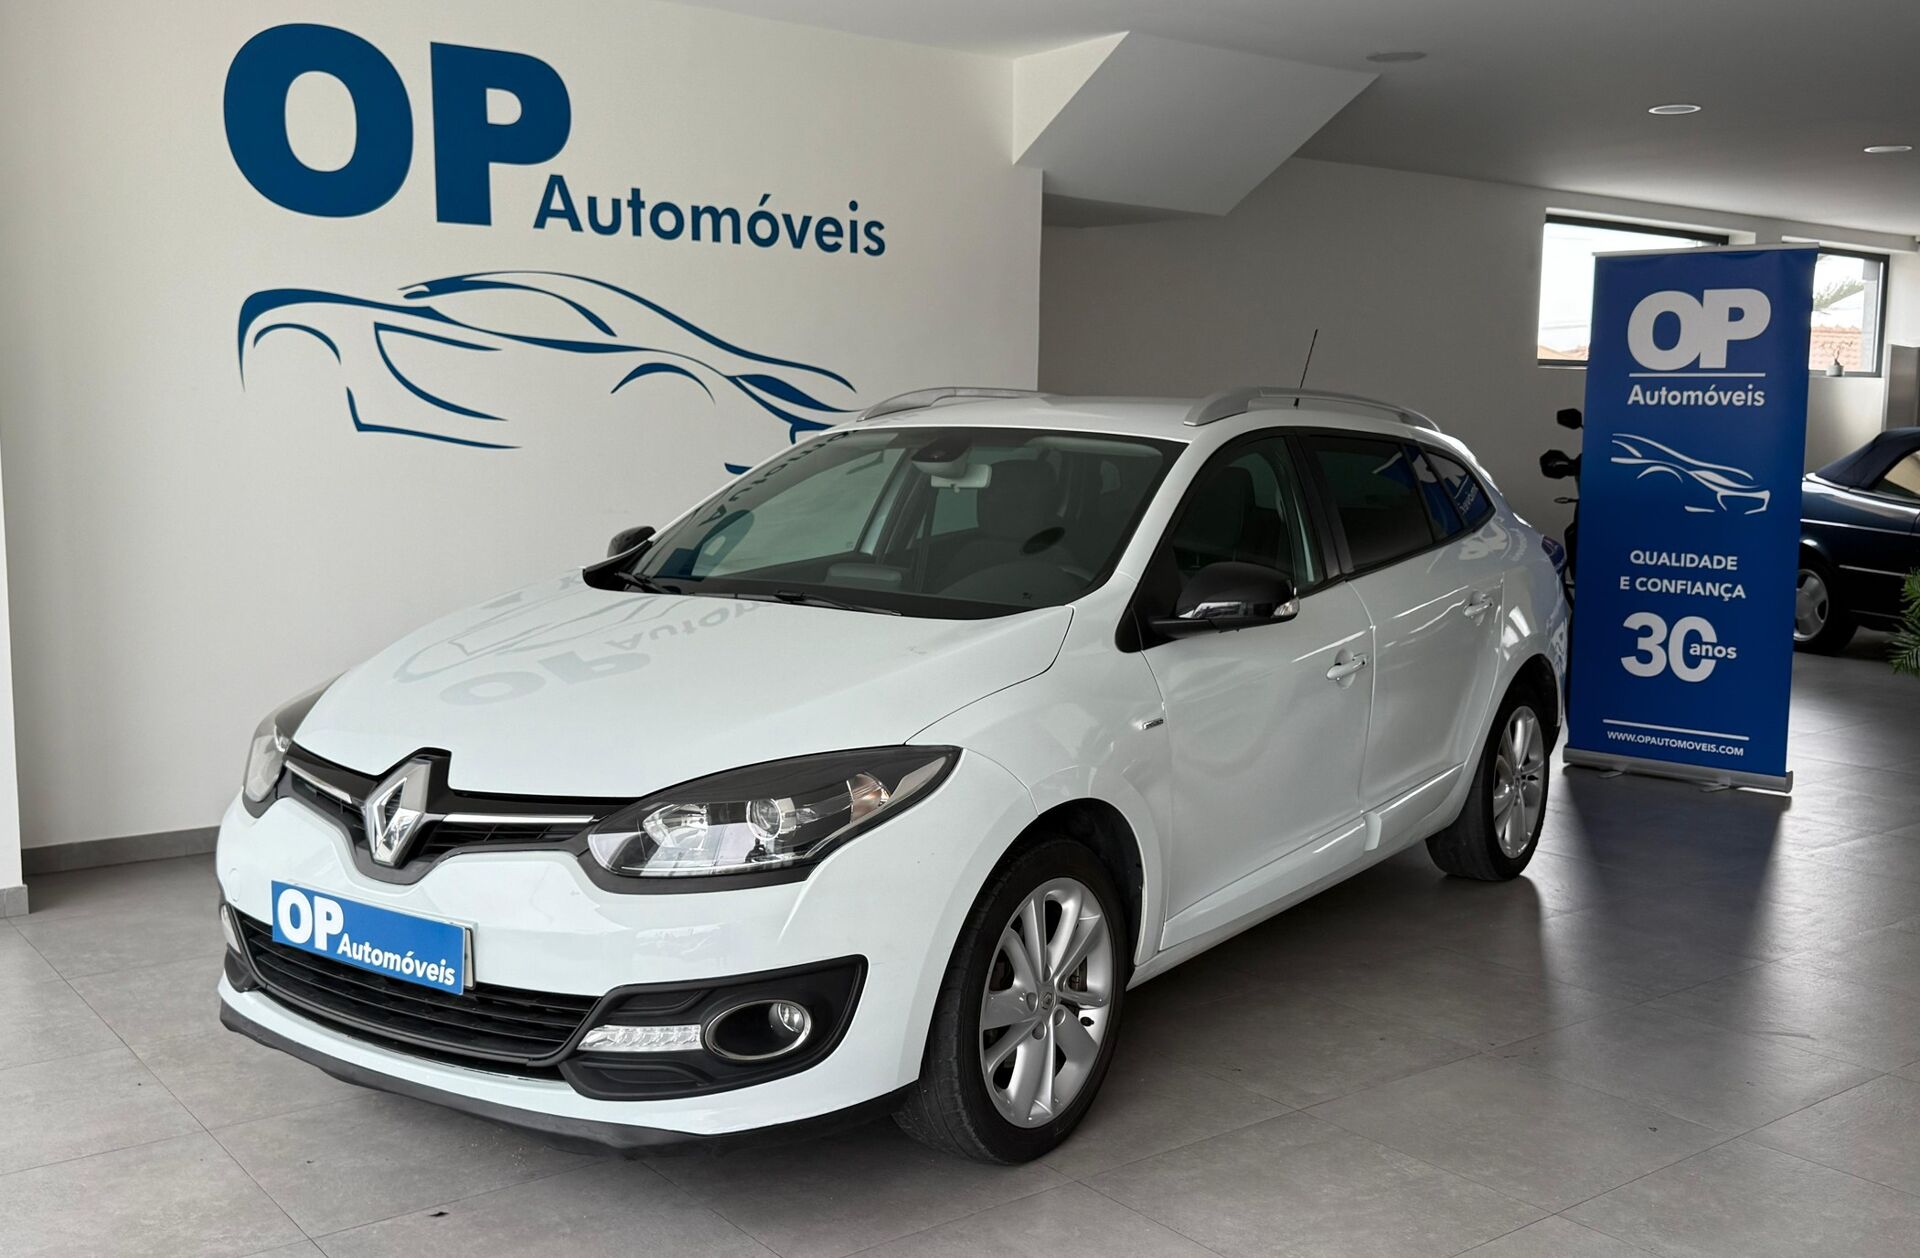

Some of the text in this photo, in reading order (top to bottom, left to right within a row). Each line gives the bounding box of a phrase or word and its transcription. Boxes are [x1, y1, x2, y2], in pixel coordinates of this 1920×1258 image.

[223, 22, 886, 257] OP Automóveis
[1627, 288, 1772, 371] OP
[1627, 383, 1766, 407] Automóveis
[1630, 550, 1738, 571] QUALIDADE
[1619, 576, 1746, 602] E CONFIANÇA
[1620, 612, 1737, 683] 30 anos
[1607, 731, 1744, 757] WWW.OPAUTOMOVEIS.COM
[277, 888, 456, 986] OP Automóveis
